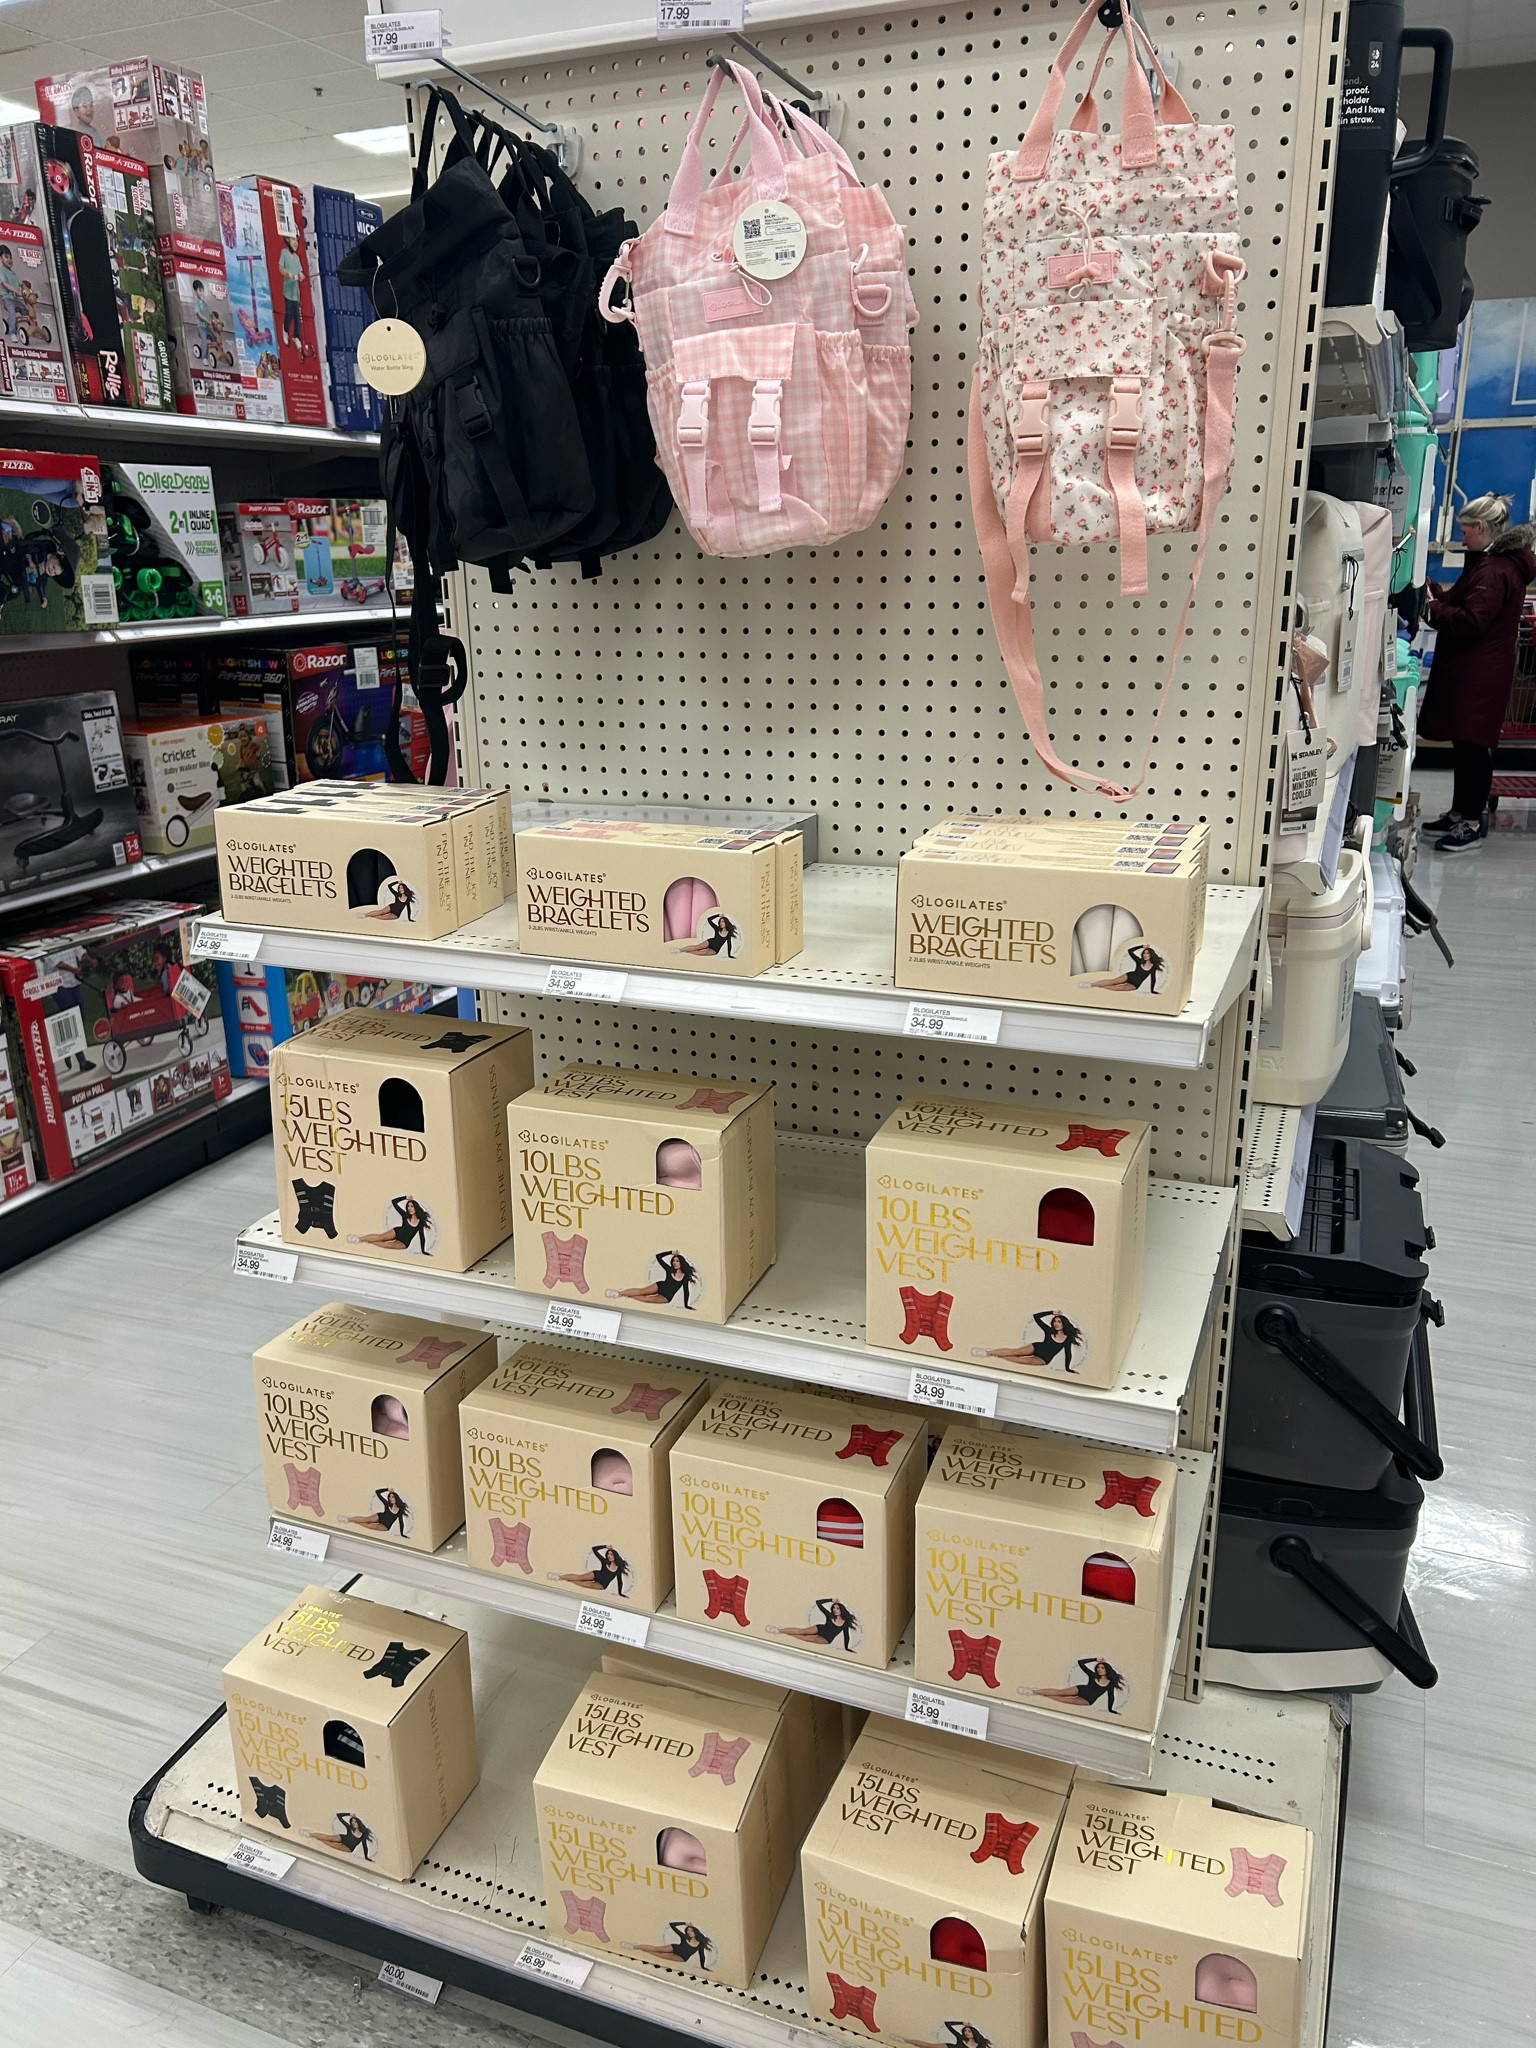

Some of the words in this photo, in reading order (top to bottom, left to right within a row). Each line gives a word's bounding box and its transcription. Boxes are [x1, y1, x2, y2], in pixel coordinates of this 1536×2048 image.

[371, 21, 401, 29] BLOGILATES
[661, 7, 689, 20] 17.99
[372, 33, 398, 45] 17.99
[1343, 96, 1369, 105] holder
[1346, 86, 1369, 96] proof.
[1346, 106, 1362, 114] And
[1369, 105, 1385, 113] have
[84, 153, 97, 207] Razor
[132, 185, 141, 215] SCOOTER
[356, 221, 379, 235] MICR
[158, 341, 169, 365] GROW
[100, 350, 121, 399] Rollie
[161, 365, 171, 390] WITH
[164, 391, 171, 403] ME
[3, 461, 33, 470] FLYER
[84, 468, 97, 501] 4-IN-1
[189, 510, 210, 519] INLINE
[298, 503, 329, 515] Razor
[191, 521, 211, 530] QUAD
[196, 547, 218, 555] SIZING
[307, 654, 347, 669] Razor
[162, 748, 196, 763] Cricket
[1299, 748, 1323, 759] STANLEY
[180, 763, 197, 772] Walker
[1292, 769, 1317, 782] JULIENNE
[1292, 781, 1304, 791] MINI
[1305, 778, 1318, 788] SOFT
[1292, 788, 1312, 801] COOLER
[226, 839, 296, 853] BLOGILATES
[227, 855, 332, 879] WEIGHTED
[527, 868, 606, 883] BLOGILATES
[230, 874, 337, 899] BRACELETS
[527, 884, 646, 912] WEIGHTED
[911, 895, 1007, 911] BLOGILATES
[528, 904, 649, 933] BRACELETS
[911, 913, 1054, 942] WEIGHTED
[197, 940, 221, 949] 34.99
[909, 934, 1056, 965] BRACELETS
[927, 958, 963, 967] WRIST/ANKLE
[45, 978, 63, 991] WAGON
[548, 979, 575, 989] 34.99
[911, 1017, 943, 1029] 34.99
[914, 1007, 950, 1015] BLOGILATES
[72, 1093, 86, 1105] PUSH
[91, 1083, 105, 1095] PULL
[278, 1072, 359, 1093] BLOGILATES
[553, 1080, 677, 1100] WEIGHTED
[281, 1094, 352, 1125] 15LBS
[903, 1112, 1049, 1137] WEIGHTED
[281, 1119, 427, 1162] WEIGHTED
[518, 1130, 608, 1150] BLOGILATES
[283, 1144, 347, 1175] VEST
[520, 1149, 601, 1181] 10LBS
[520, 1174, 675, 1216] WEIGHTED
[877, 1175, 984, 1200] BLOGILATES
[521, 1199, 589, 1229] VEST
[877, 1195, 972, 1233] 10LBS
[876, 1221, 1059, 1274] WEIGHTED
[238, 1258, 259, 1269] 34.99
[876, 1248, 955, 1283] VEST
[548, 1315, 573, 1327] 34.99
[551, 1305, 580, 1315] BLOGILATES
[301, 1322, 404, 1350] WEIGHTED
[511, 1359, 573, 1379] 10LBS
[916, 1373, 950, 1384] BLOGILATES
[262, 1377, 334, 1399] BLOGILATES
[491, 1379, 546, 1398] VEST
[502, 1369, 615, 1400] WEIGHTED
[914, 1383, 944, 1398] 34.99
[264, 1392, 330, 1424] 10LBS
[717, 1398, 782, 1418] 10LBS
[265, 1413, 388, 1459] WEIGHTED
[700, 1420, 759, 1440] VEST
[709, 1409, 833, 1442] WEIGHTED
[266, 1434, 321, 1463] VEST
[467, 1427, 548, 1452] BLOGILATES
[468, 1444, 542, 1478] 10LBS
[950, 1444, 1023, 1466] 10LBS
[940, 1468, 1004, 1490] VEST
[946, 1456, 1086, 1490] WEIGHTED
[469, 1466, 608, 1515] WEIGHTED
[680, 1474, 769, 1501] BLOGILATES
[470, 1488, 532, 1518] VEST
[680, 1491, 761, 1527] 10LBS
[272, 1534, 292, 1546] 34.99
[681, 1513, 835, 1567] WEIGHTED
[681, 1536, 749, 1569] VEST
[925, 1529, 1030, 1556] BLOGILATES
[926, 1548, 1019, 1585] 10LBS
[926, 1570, 1102, 1625] WEIGHTED
[580, 1615, 604, 1629] 34.99
[583, 1606, 610, 1617] BLOGILATES
[926, 1593, 1003, 1628] VEST
[262, 1634, 312, 1658] VEST
[276, 1622, 376, 1662] WEIGHTED
[232, 1693, 307, 1726] BLOGILATES
[911, 1703, 939, 1718] 34.99
[913, 1693, 945, 1705] BLOGILATES
[584, 1703, 644, 1728] 15LBS
[235, 1709, 300, 1748] 15LBS
[576, 1718, 694, 1758] WEIGHTED
[237, 1728, 368, 1790] WEIGHTED
[567, 1734, 622, 1759] VEST
[240, 1748, 296, 1784] VEST
[857, 1772, 920, 1804] 15LBS
[544, 1805, 636, 1835] BLOGILATES
[841, 1803, 900, 1835] VEST
[849, 1786, 977, 1841] WEIGHTED
[1084, 1813, 1155, 1841] 15LBS
[547, 1821, 627, 1859] 15LBS
[1081, 1829, 1225, 1876] WEIGHTED
[233, 1851, 254, 1863] 46.99
[549, 1840, 709, 1899] WEIGHTED
[1077, 1846, 1141, 1875] VEST
[551, 1861, 620, 1896] VEST
[815, 1882, 914, 1927] BLOGILATES
[817, 1898, 900, 1950] 15LBS
[818, 1920, 992, 1998] WEIGHTED
[1062, 1928, 1178, 1966] BLOGILATES
[384, 1964, 405, 1980] 40.00
[520, 1954, 545, 1969] 46.99
[818, 1940, 892, 1988] VEST
[1063, 1947, 1161, 1994] 15LBS
[1063, 1971, 1262, 2043] WEIGHTED
[1063, 1996, 1150, 2040] VEST
